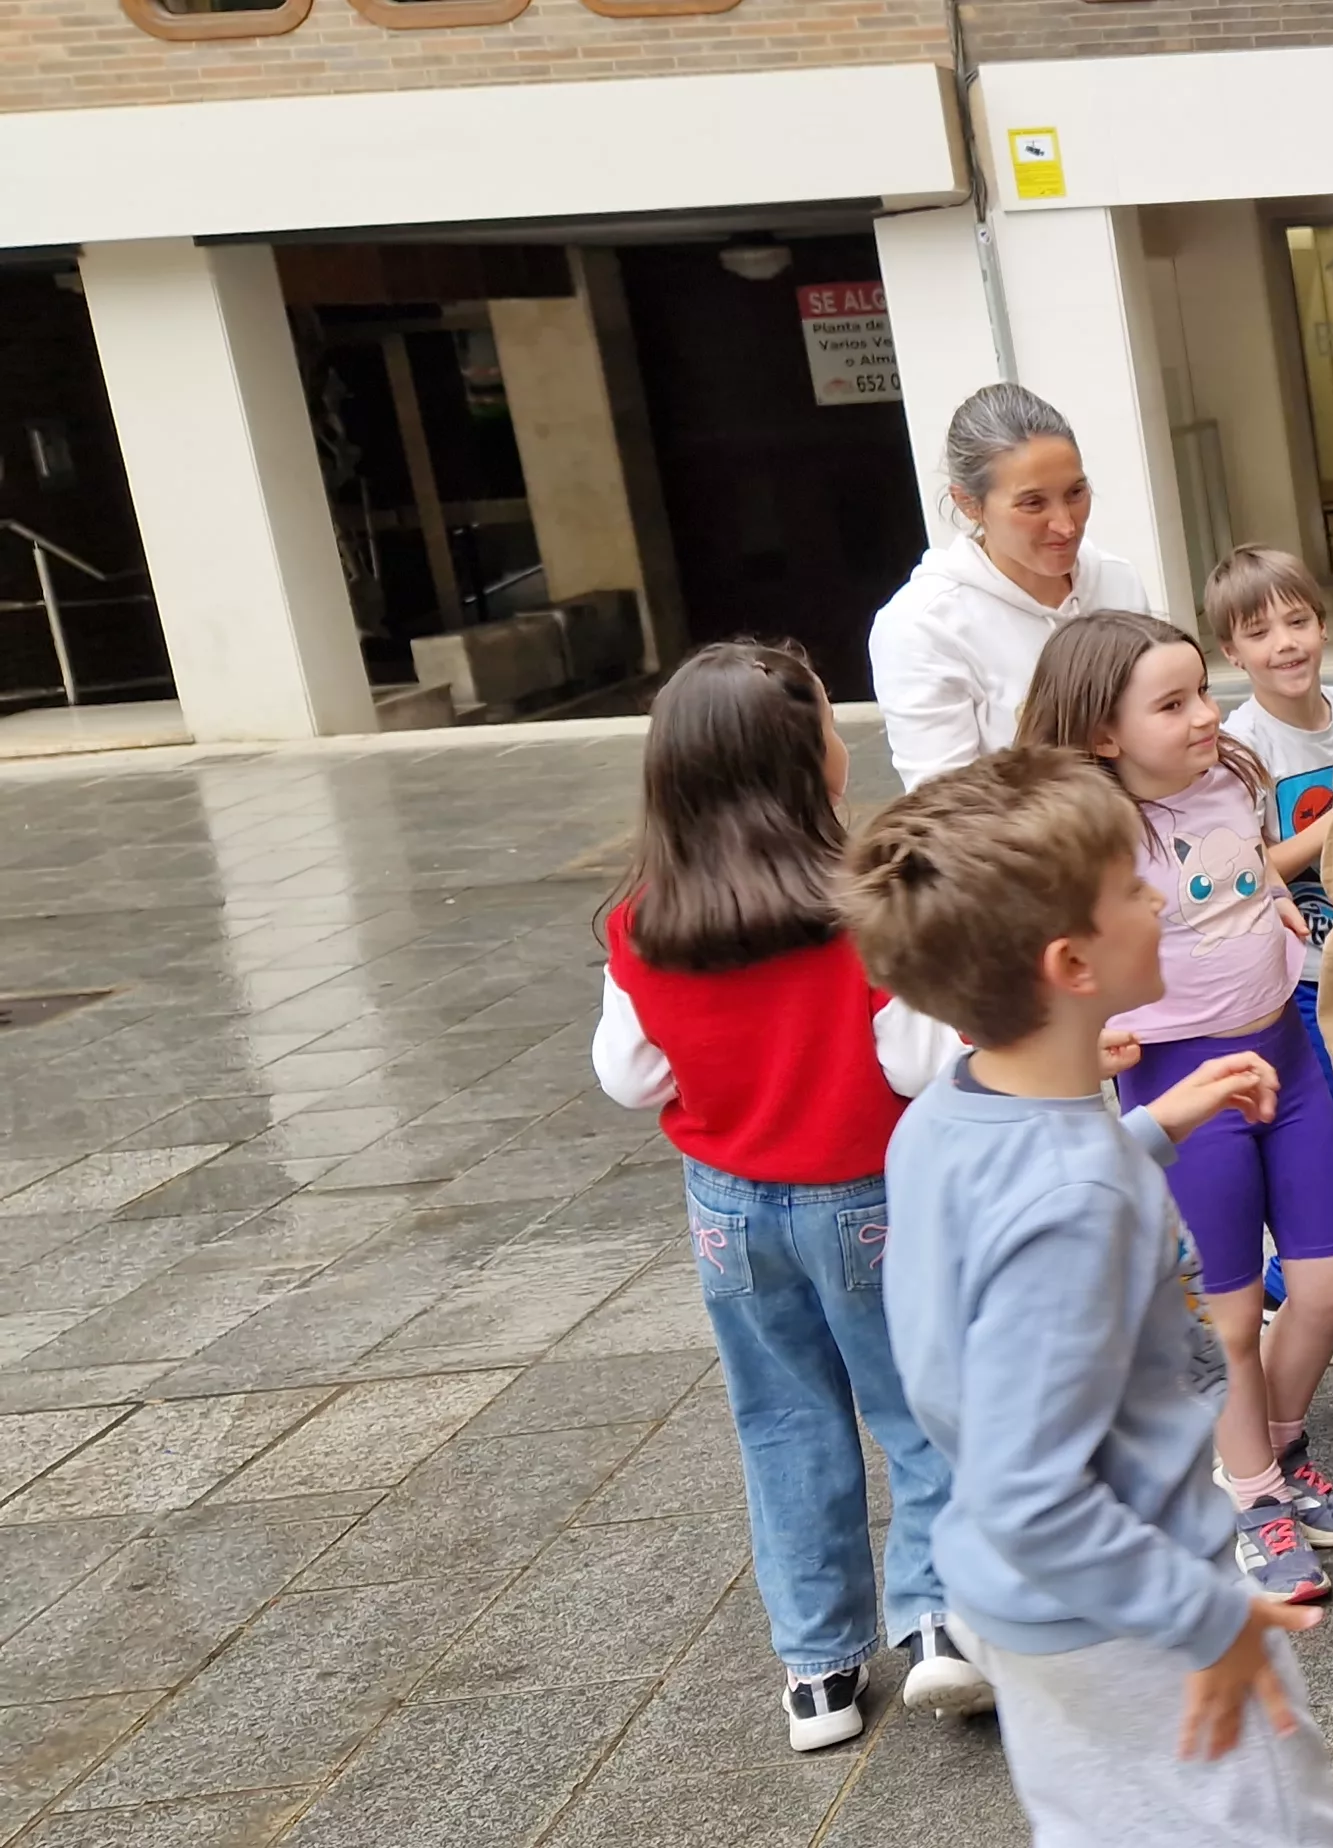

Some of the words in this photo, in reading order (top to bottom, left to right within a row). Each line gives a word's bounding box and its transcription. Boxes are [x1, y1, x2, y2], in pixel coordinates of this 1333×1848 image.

[809, 291, 838, 314] SE
[812, 321, 861, 334] Planta
[865, 320, 884, 332] de
[819, 339, 868, 351] Varios
[845, 357, 855, 368] o
[856, 374, 886, 393] 652
